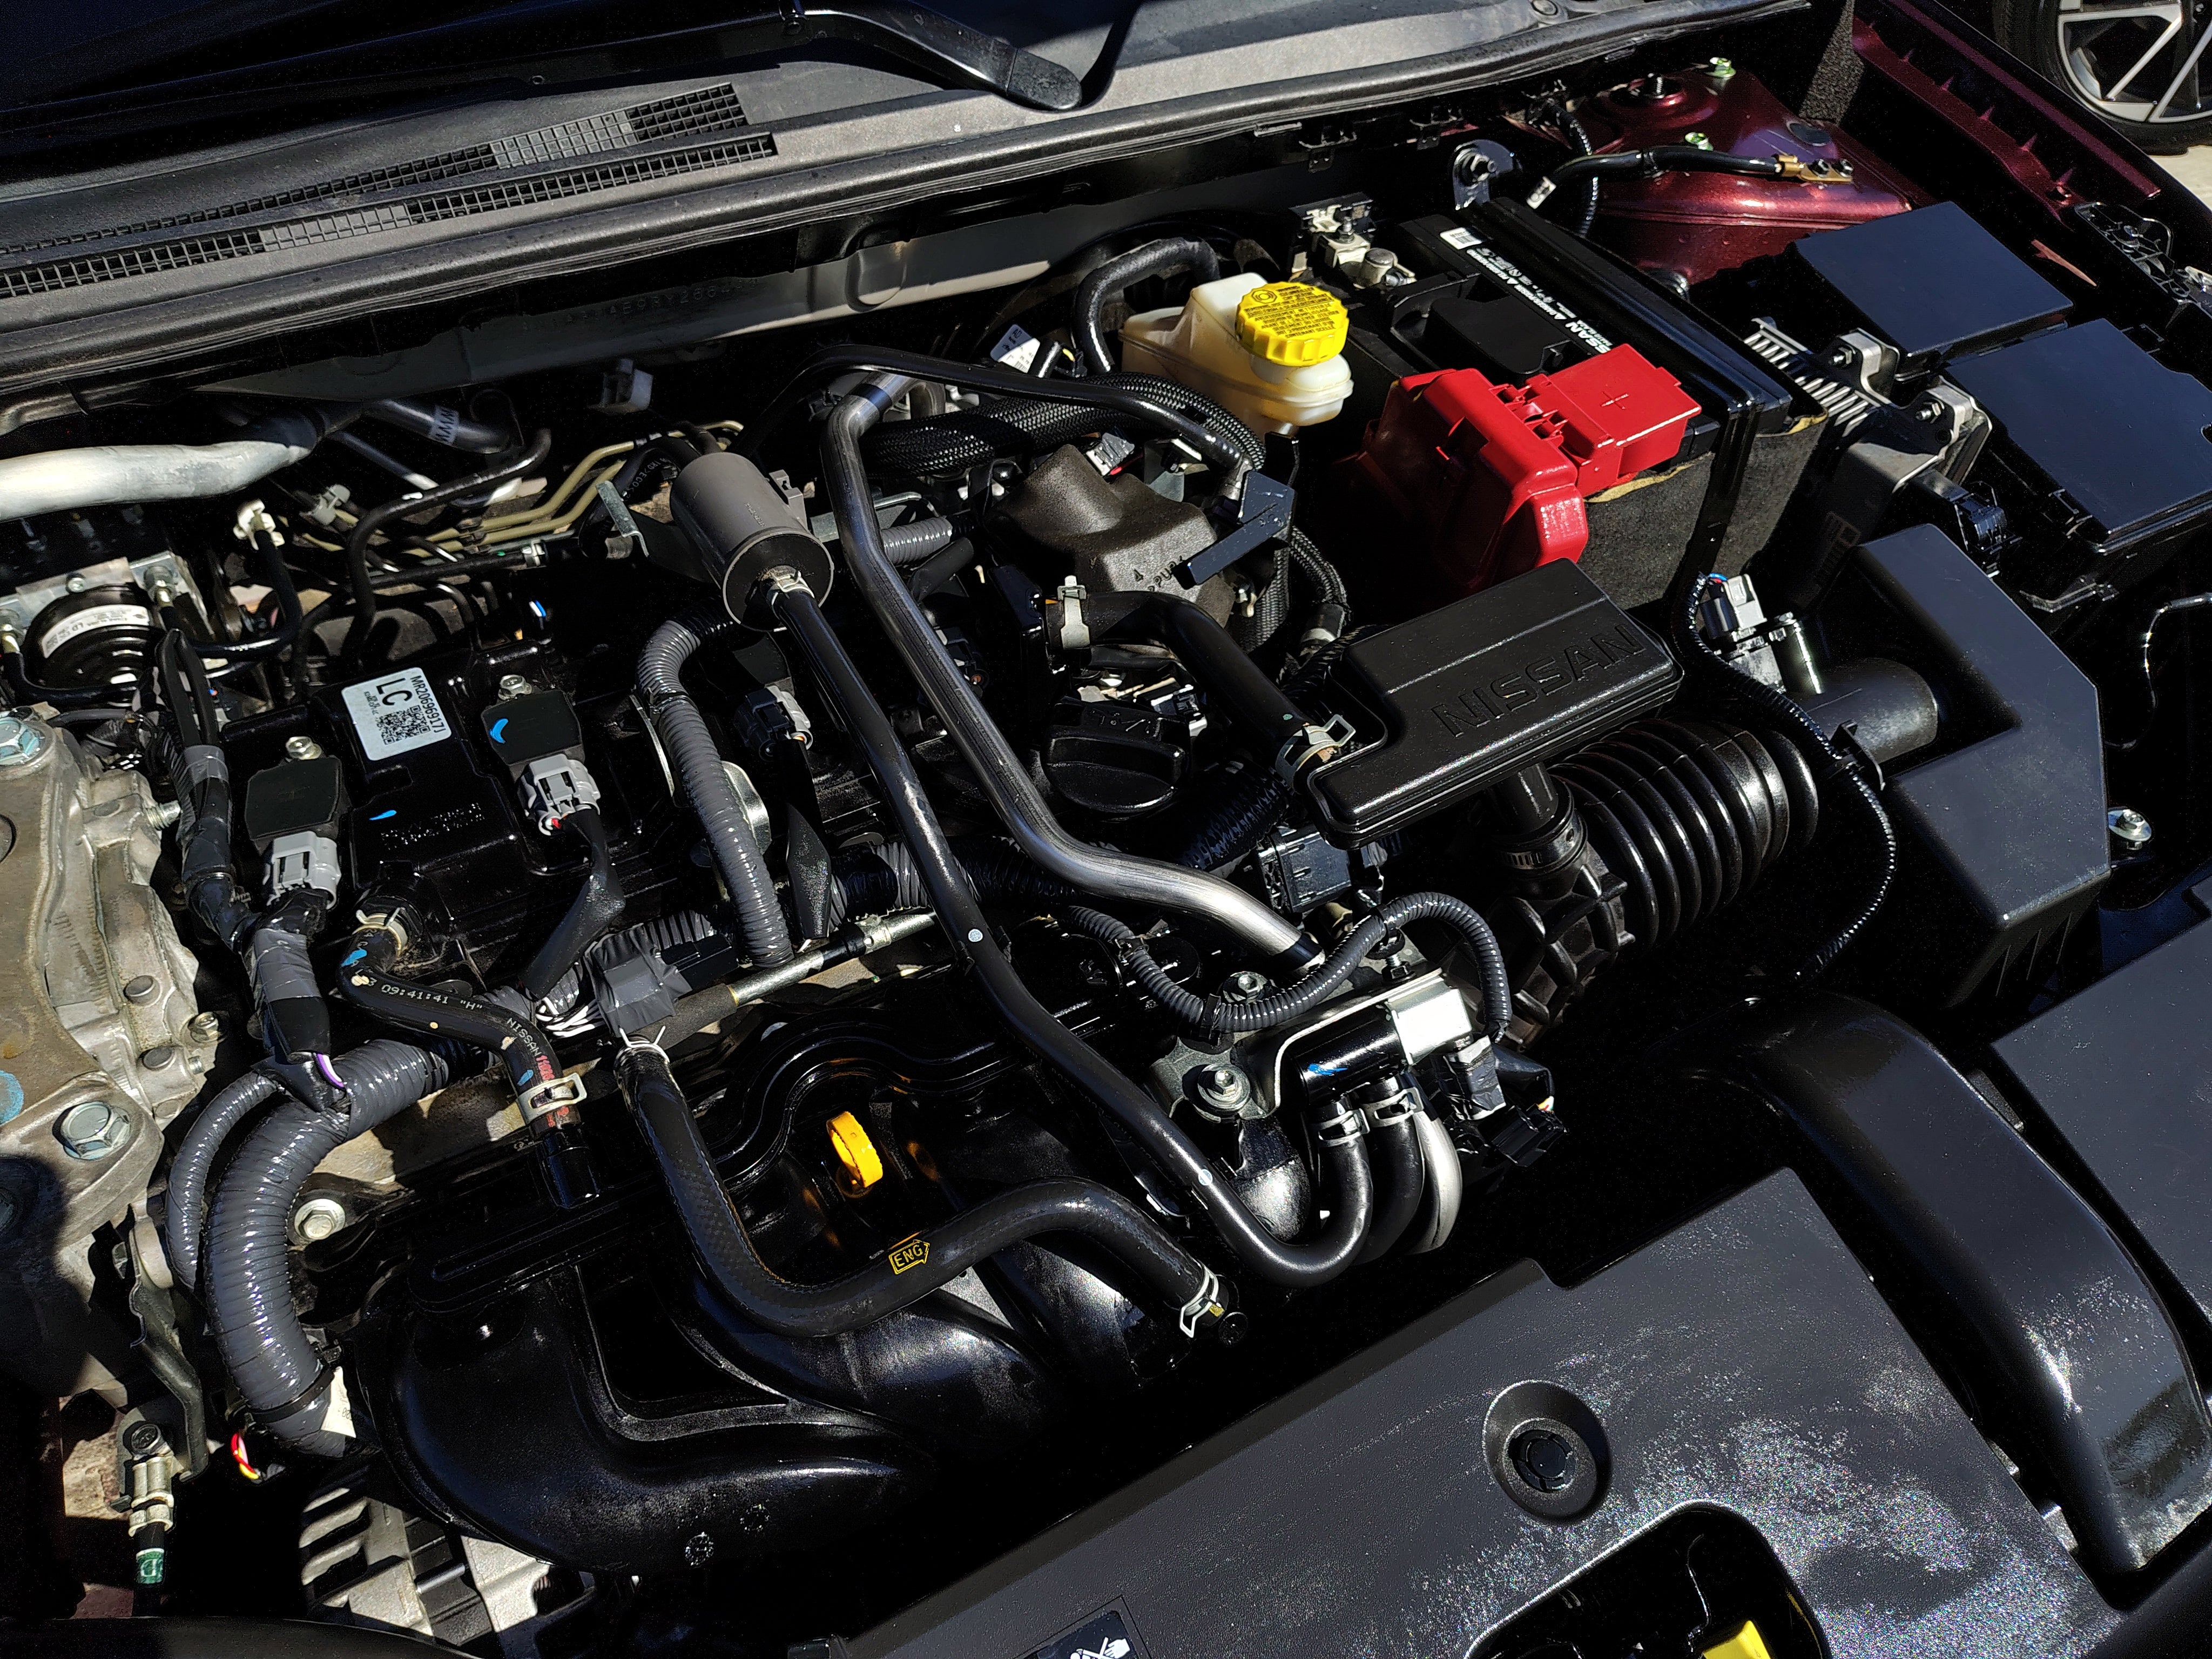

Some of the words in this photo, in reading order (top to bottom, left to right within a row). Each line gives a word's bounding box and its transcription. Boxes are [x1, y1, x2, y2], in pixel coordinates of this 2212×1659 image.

[376, 677, 413, 706] LC
[410, 675, 447, 733] MR20696917J
[1431, 624, 1646, 737] NISSAN
[381, 983, 449, 1004] 09:41:41
[506, 1017, 542, 1057] NISSAN
[894, 1244, 923, 1267] ENG
